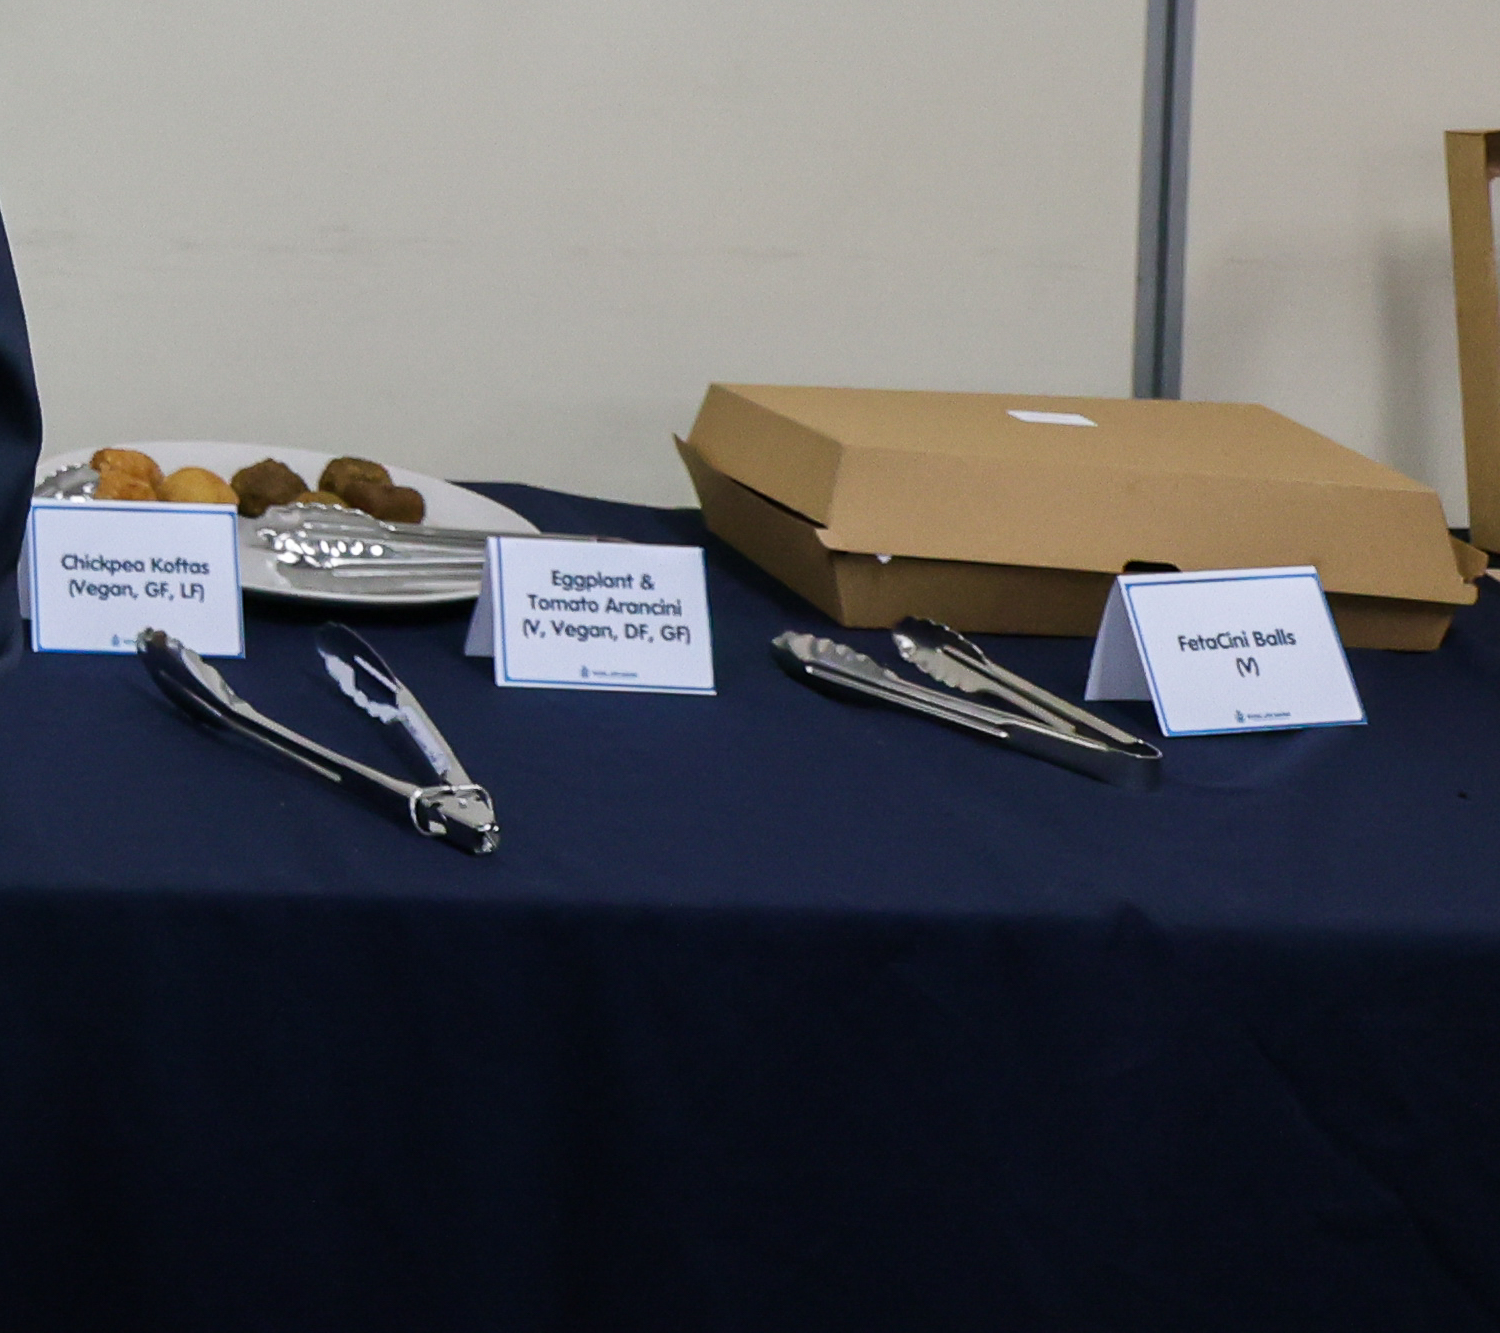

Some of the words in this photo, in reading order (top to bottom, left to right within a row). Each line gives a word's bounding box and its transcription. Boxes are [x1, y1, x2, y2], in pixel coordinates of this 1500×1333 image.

[61, 553, 145, 575] Chickpea
[150, 557, 210, 575] Koftas
[69, 579, 139, 601] (Vegan,
[144, 581, 174, 601] GF,
[179, 583, 205, 603] LF)
[551, 569, 634, 592] Eggplant
[640, 573, 655, 590] &
[527, 593, 599, 613] Tomato
[605, 596, 682, 617] Arancini
[523, 618, 546, 639] (V,
[551, 619, 618, 642] Vegan,
[624, 624, 654, 643] DF,
[660, 625, 691, 646] GF)
[1177, 630, 1250, 652] FetaCini
[1252, 628, 1297, 648] Balls
[1236, 656, 1260, 678] (V)
